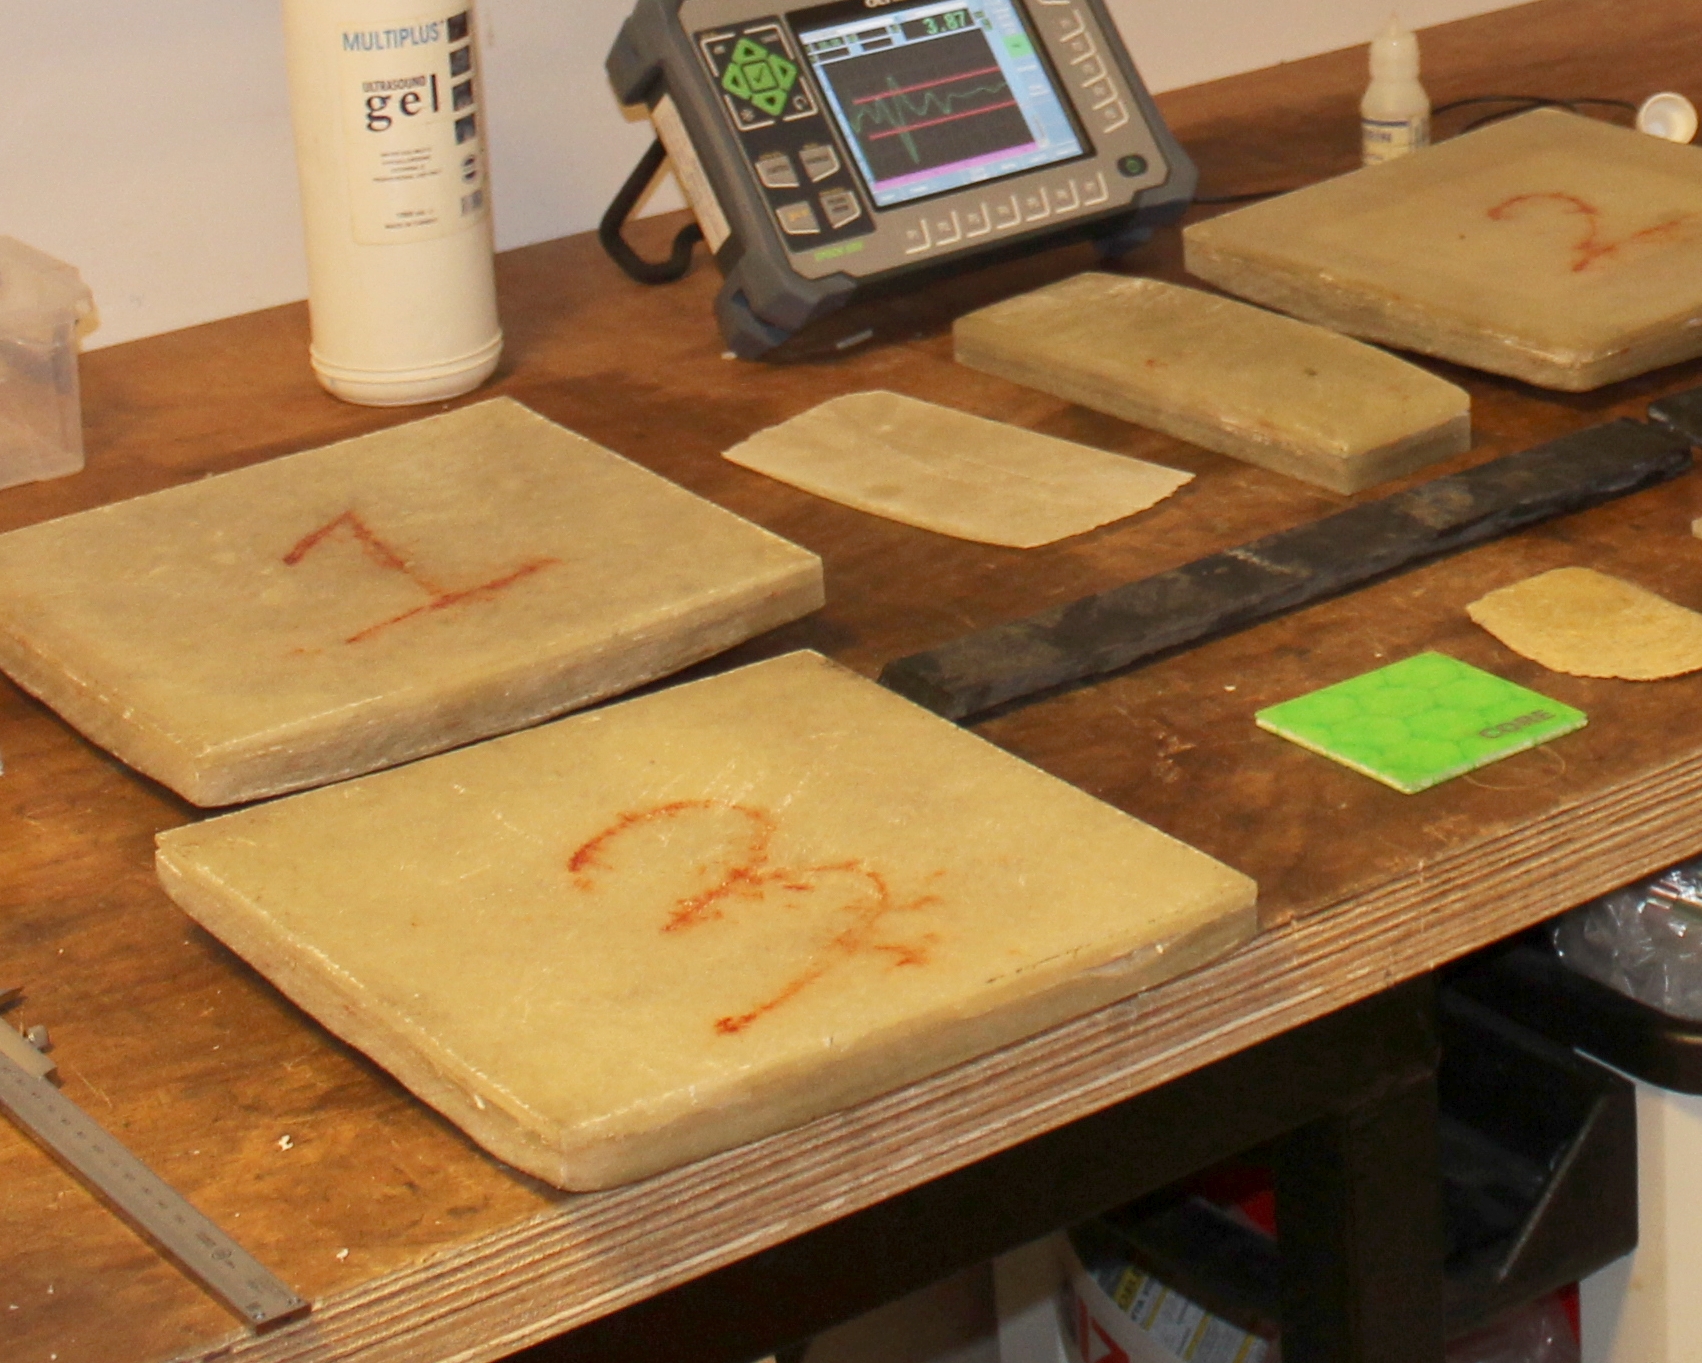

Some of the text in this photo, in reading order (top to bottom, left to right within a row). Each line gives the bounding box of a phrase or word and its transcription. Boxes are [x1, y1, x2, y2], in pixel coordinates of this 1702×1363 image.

[342, 21, 440, 52] MULTIPLUS
[922, 10, 967, 35] 3.87
[365, 73, 440, 132] gel
